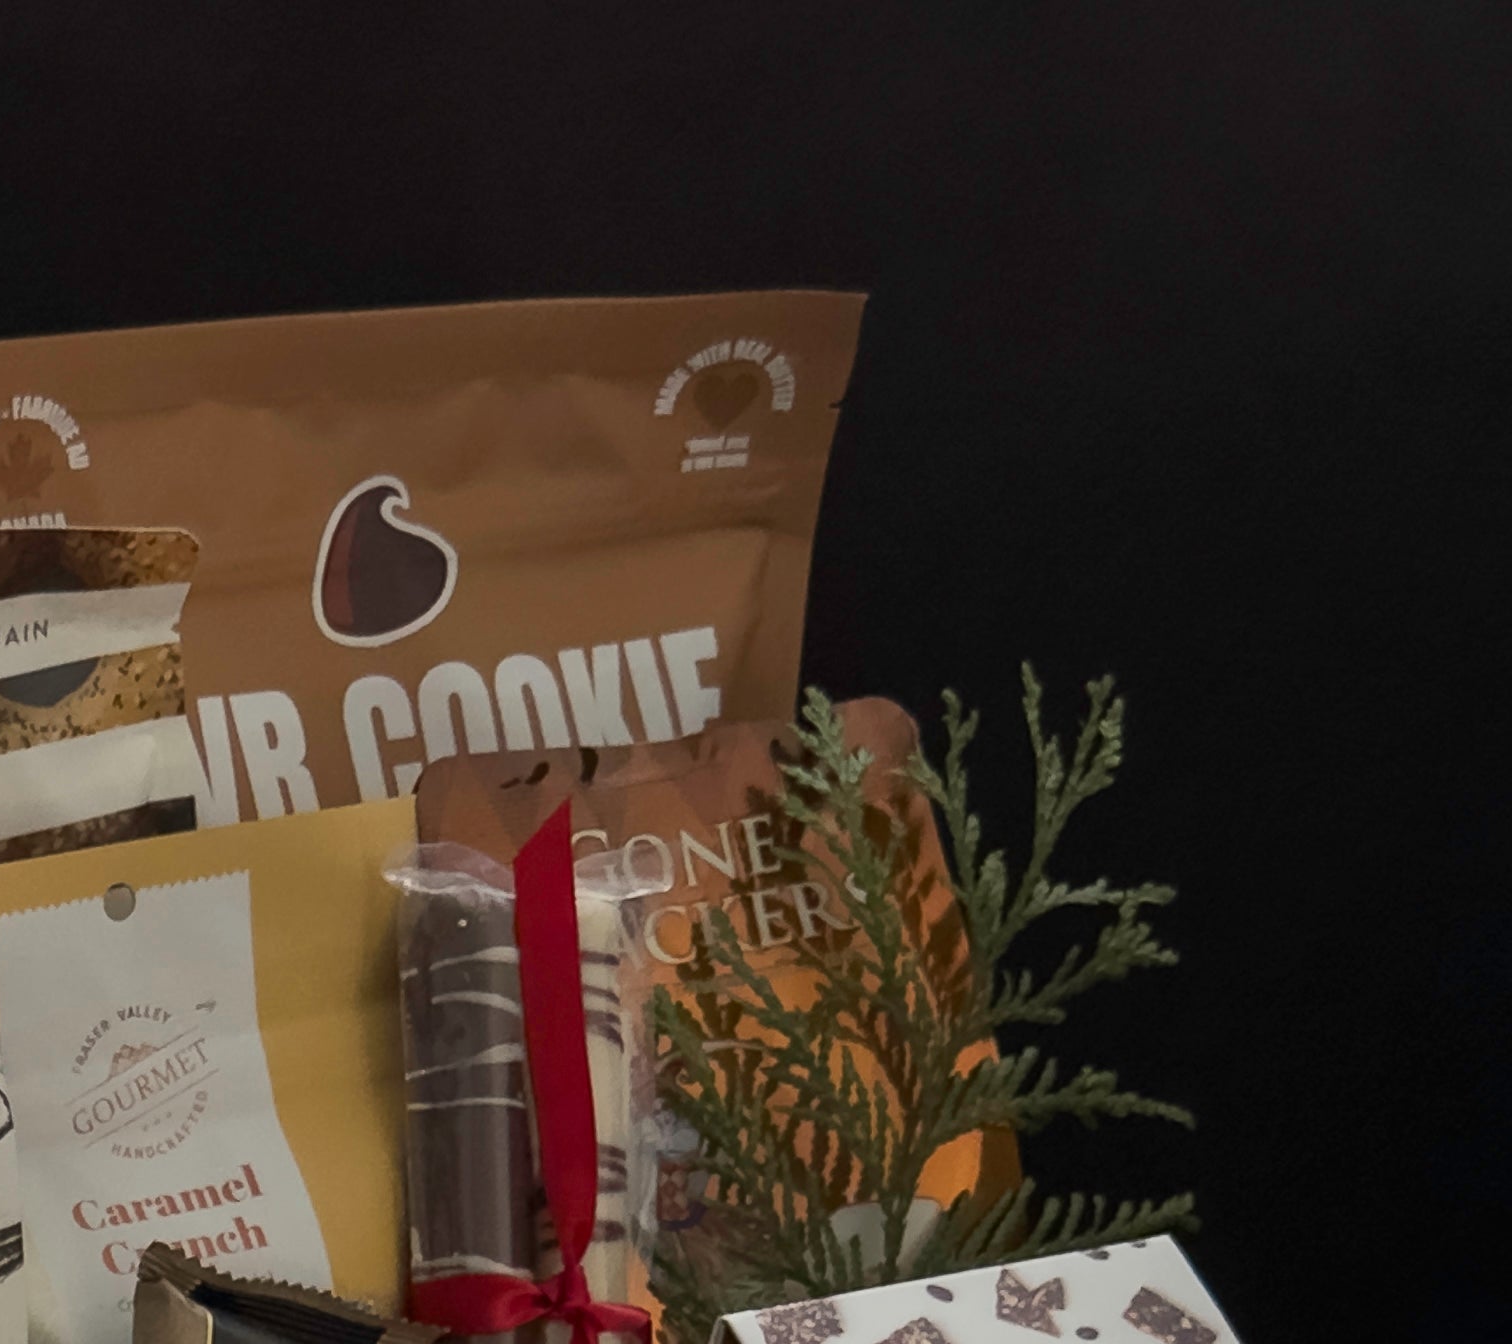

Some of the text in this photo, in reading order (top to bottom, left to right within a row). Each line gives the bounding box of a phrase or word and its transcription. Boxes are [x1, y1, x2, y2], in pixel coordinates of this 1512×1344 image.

[117, 1005, 172, 1024] VALLEY
[72, 1037, 208, 1135] GOURMET
[112, 1090, 208, 1160] HANDCRAFTED
[72, 1163, 263, 1231] Caramel
[102, 1216, 268, 1276] Cnch
